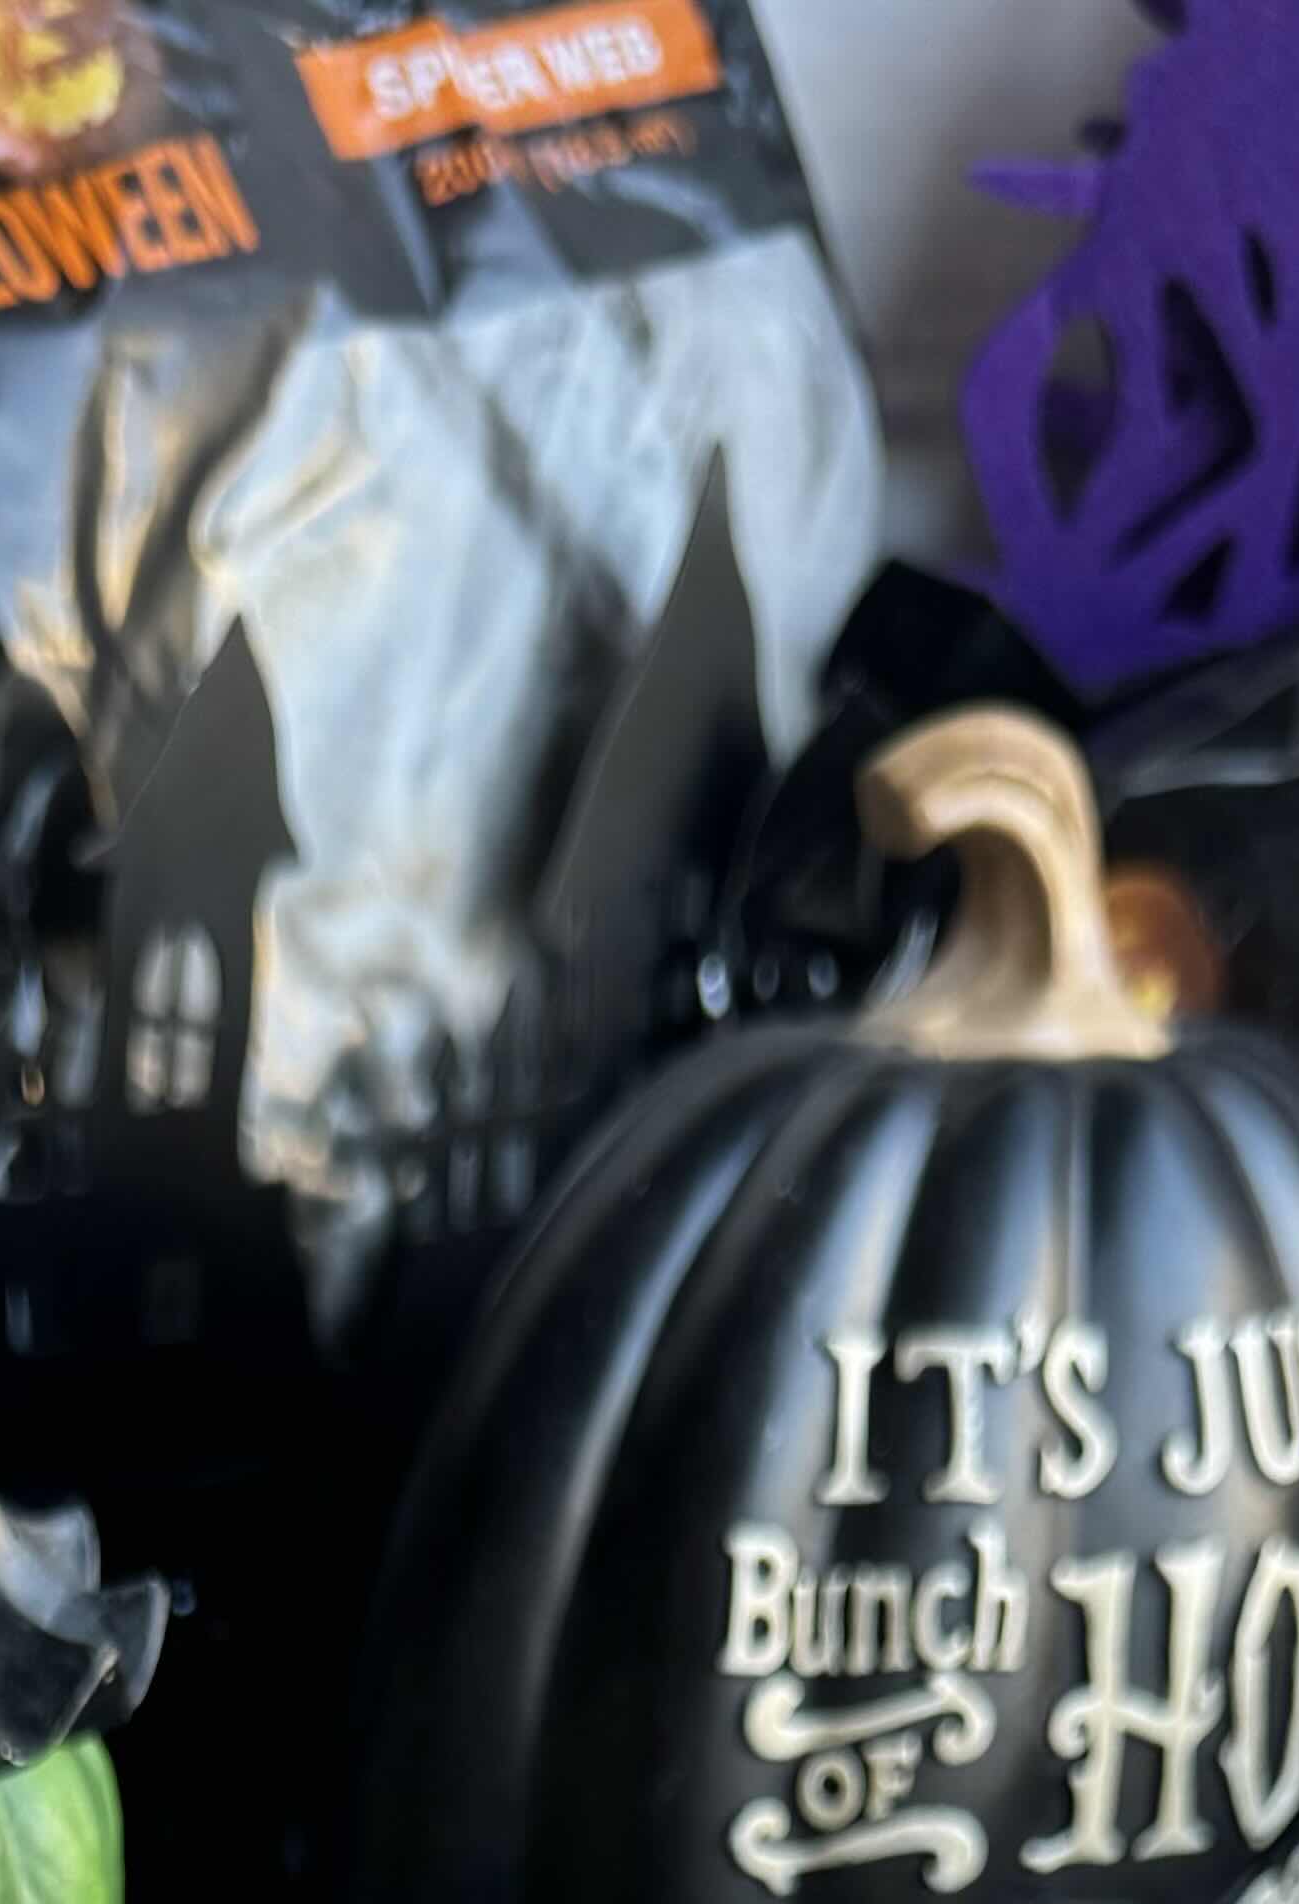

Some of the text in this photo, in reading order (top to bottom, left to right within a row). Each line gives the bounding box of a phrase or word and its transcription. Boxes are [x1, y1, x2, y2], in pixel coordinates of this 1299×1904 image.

[813, 1305, 1118, 1504] IT'S
[717, 1515, 1029, 1678] Bunch
[797, 1735, 923, 1834] OF
